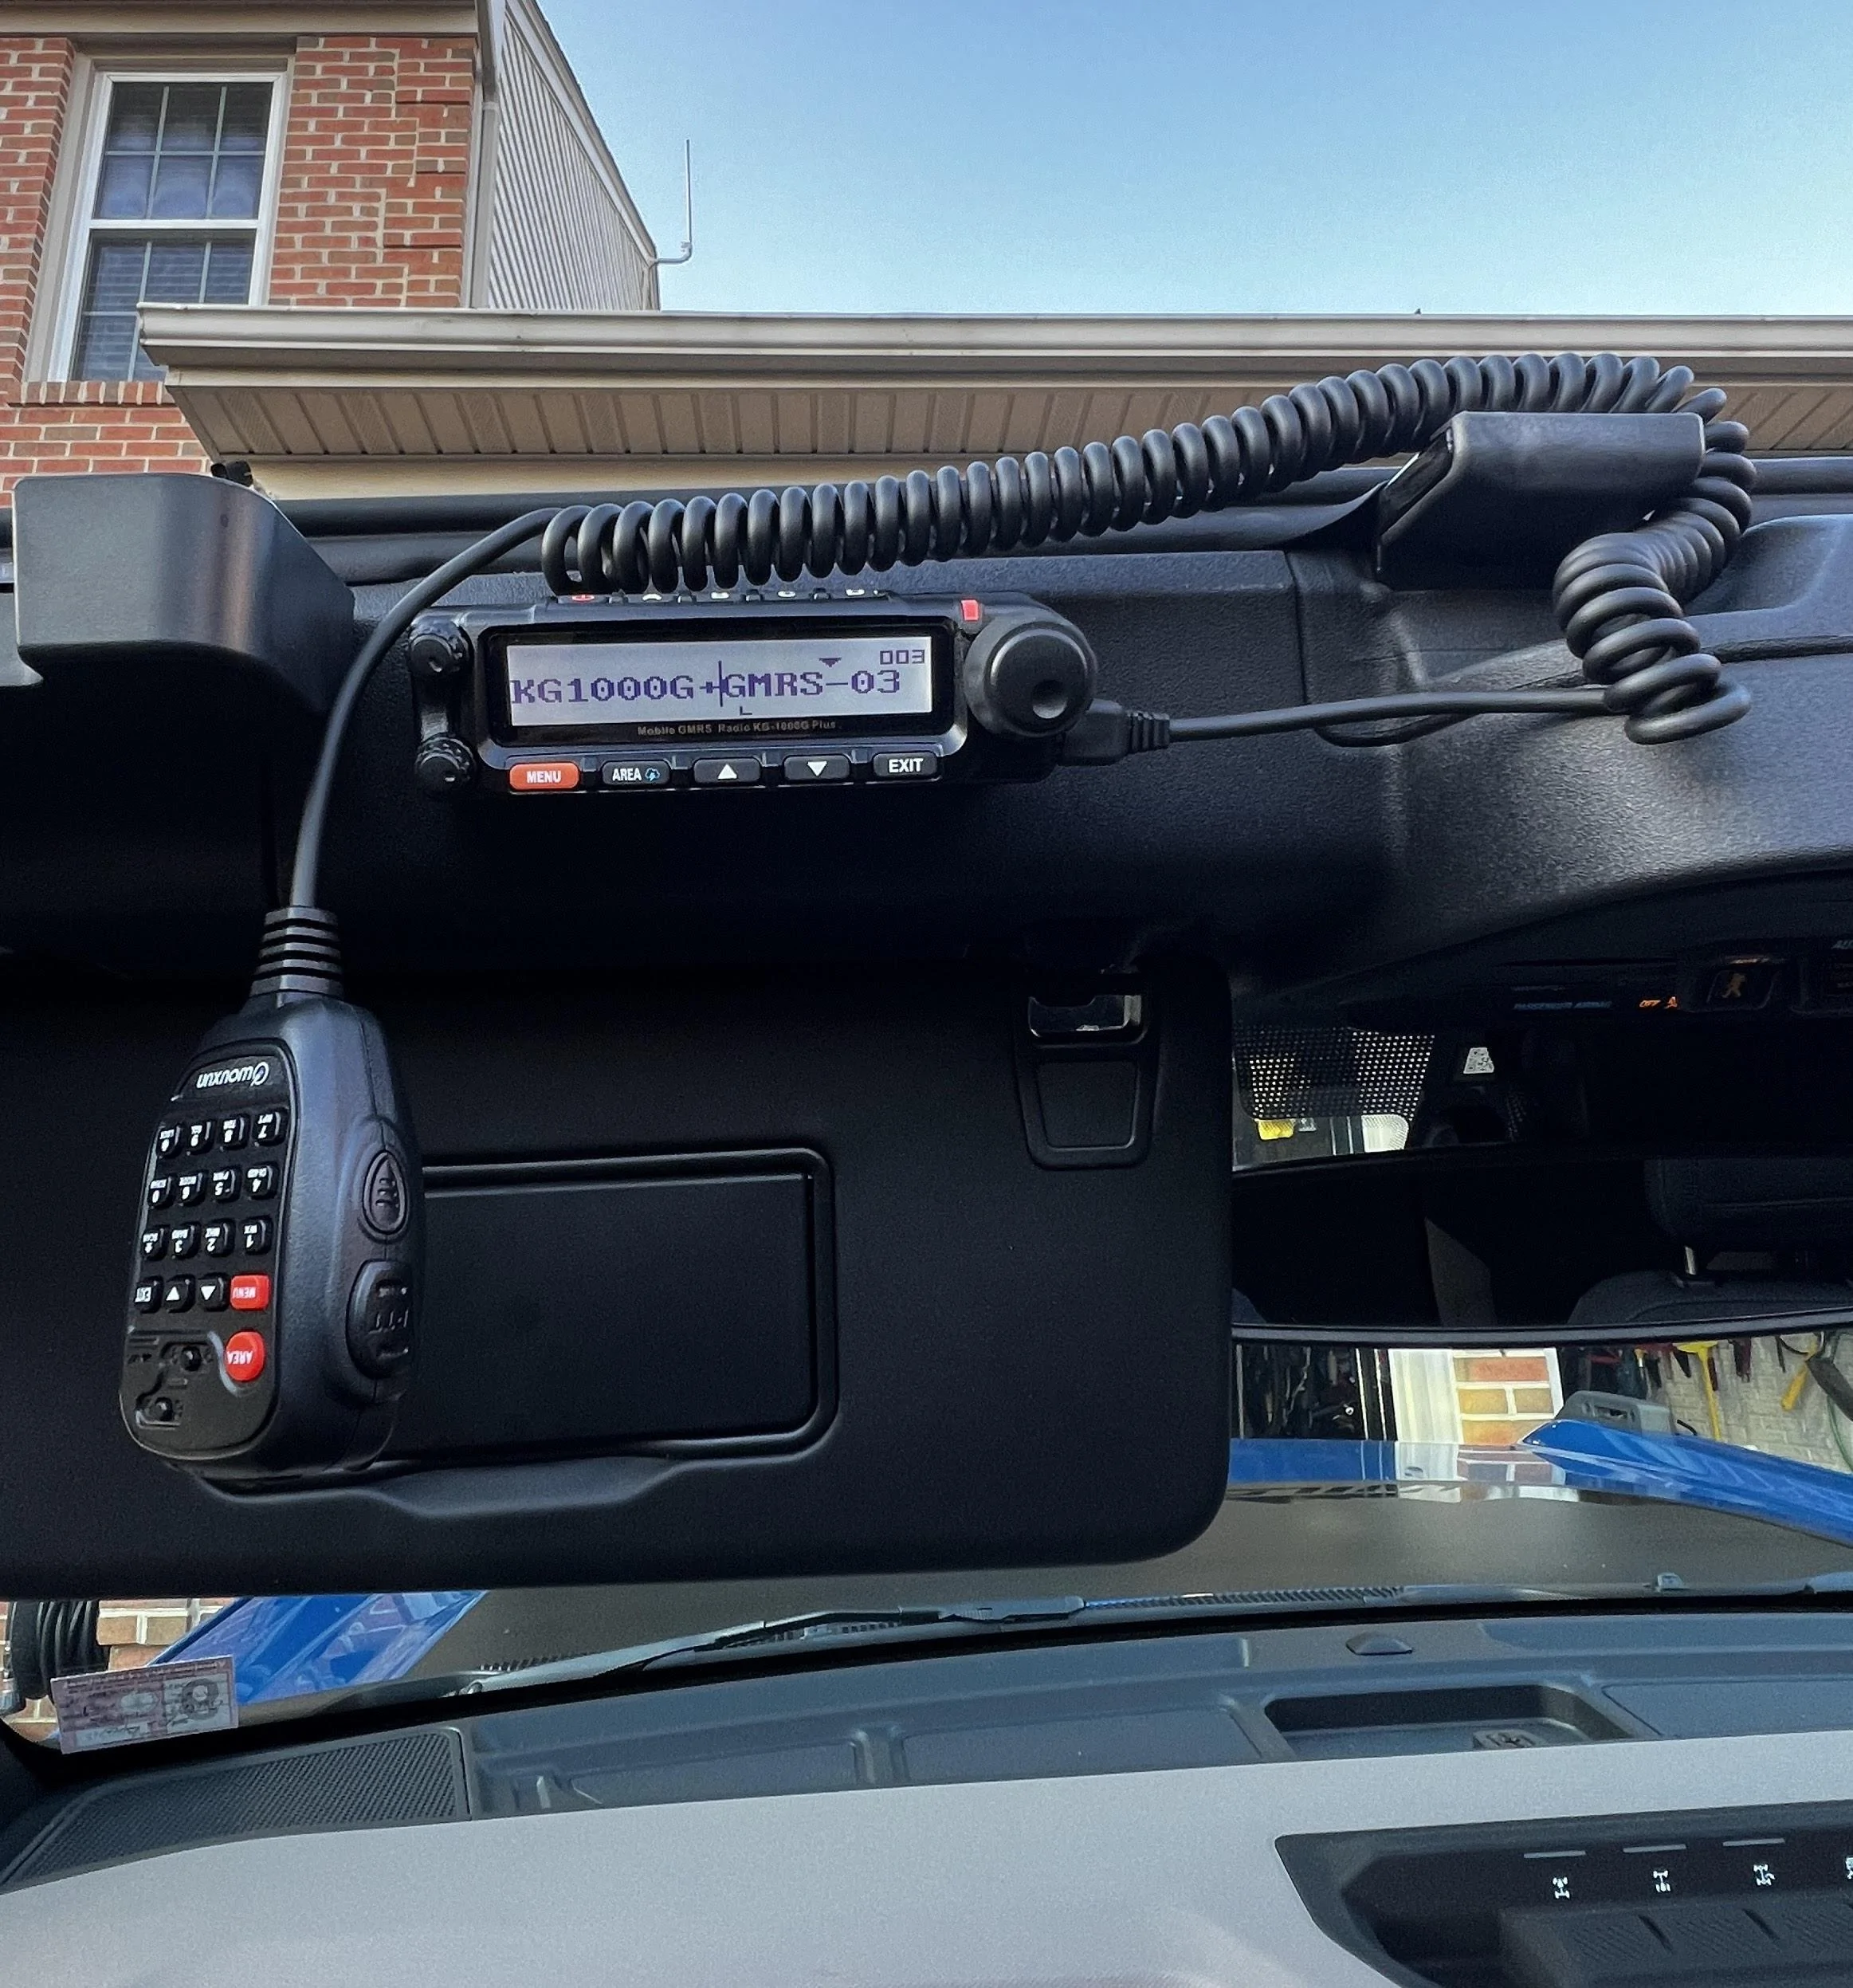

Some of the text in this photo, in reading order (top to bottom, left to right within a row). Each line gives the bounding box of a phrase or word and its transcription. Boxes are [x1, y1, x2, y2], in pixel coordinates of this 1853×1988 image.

[879, 649, 925, 665] 003
[721, 670, 900, 698] GMRS-03
[638, 725, 676, 737] Mobile
[678, 724, 712, 735] GMRS
[718, 722, 751, 733] Radio
[812, 720, 837, 729] Plus
[888, 758, 925, 773] EXIT
[526, 770, 562, 784] MENU
[612, 767, 642, 782] AREA
[257, 1125, 267, 1139] 7
[214, 1181, 224, 1196] 5
[252, 1178, 261, 1192] 4
[175, 1240, 183, 1253] 3
[206, 1237, 216, 1252] 2
[246, 1234, 254, 1248] 1
[232, 1287, 257, 1299] MENU
[226, 1350, 253, 1365] AREA
